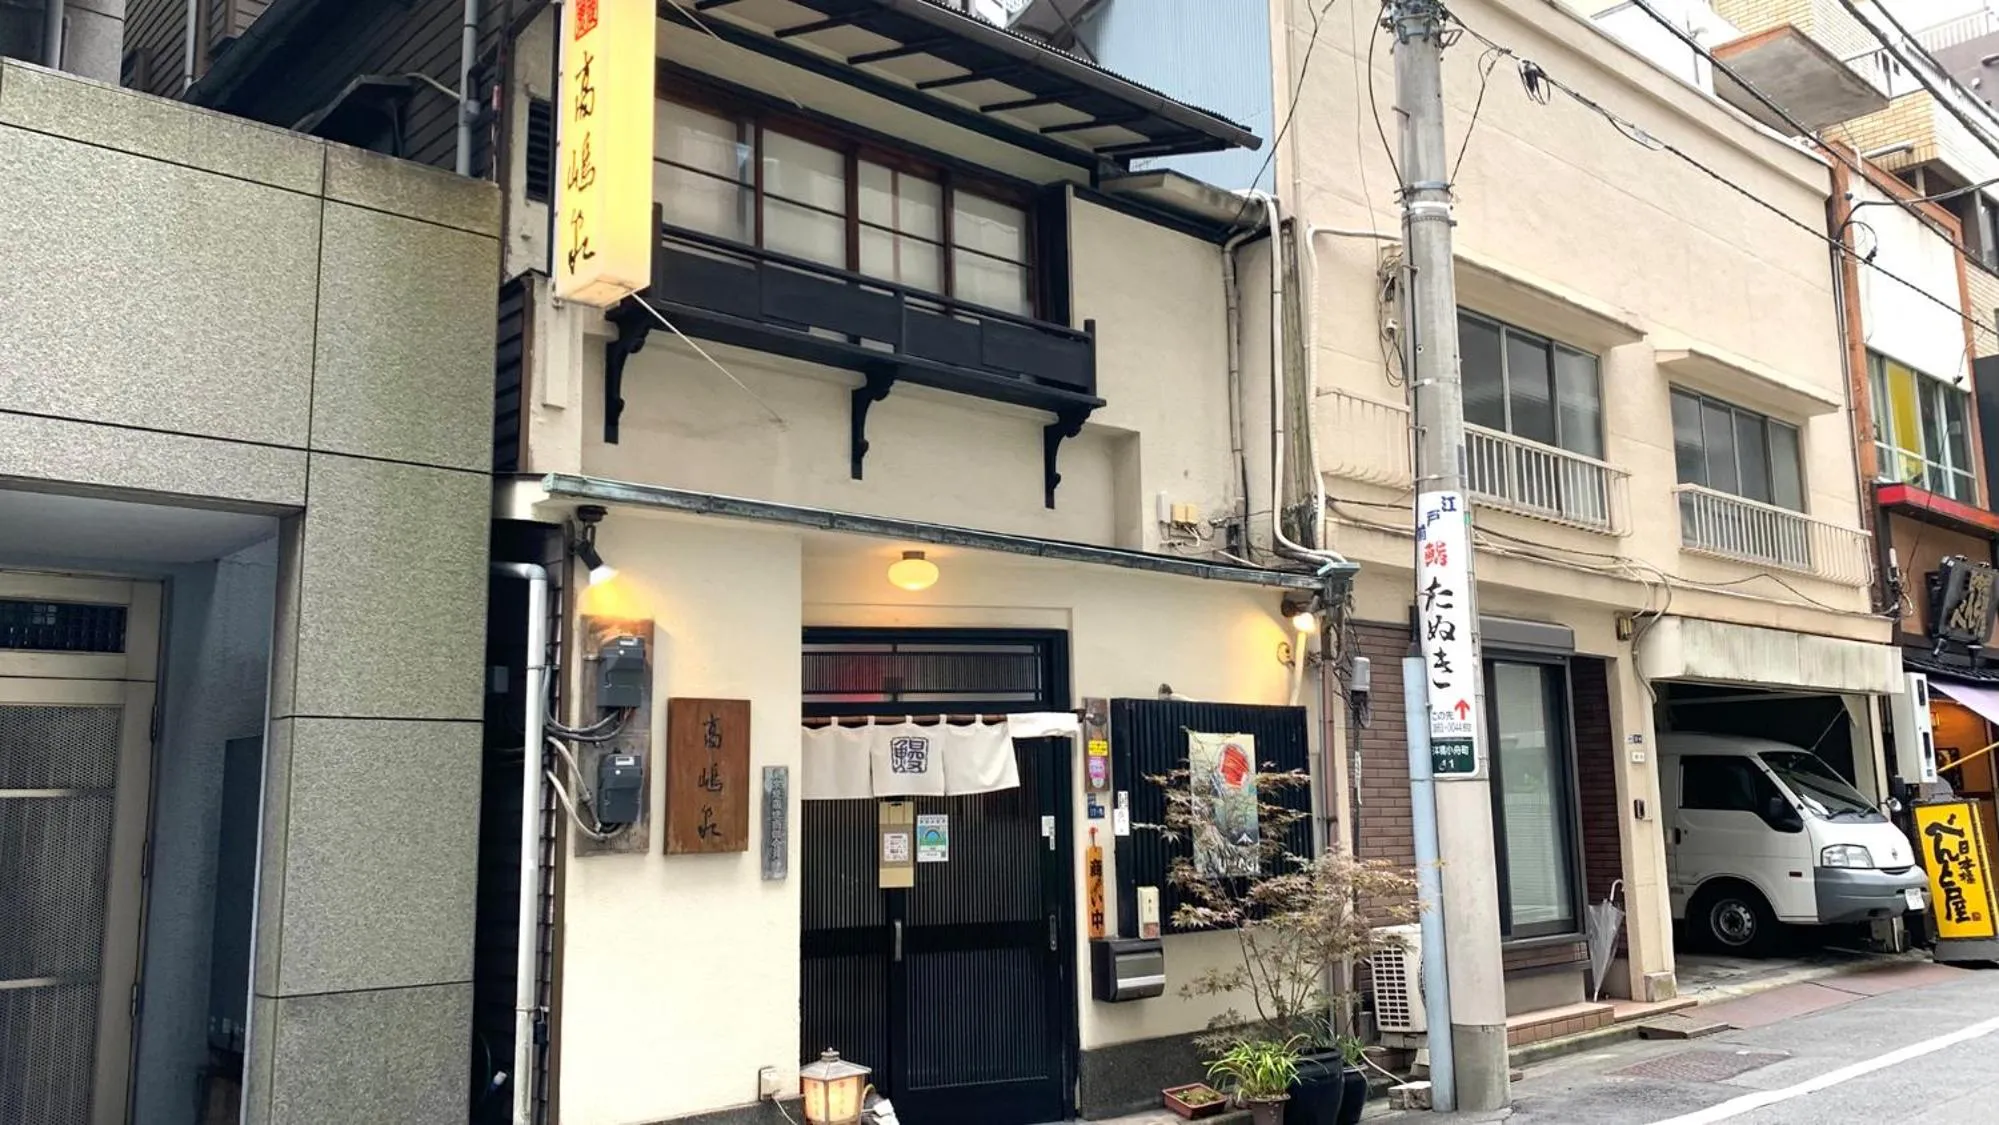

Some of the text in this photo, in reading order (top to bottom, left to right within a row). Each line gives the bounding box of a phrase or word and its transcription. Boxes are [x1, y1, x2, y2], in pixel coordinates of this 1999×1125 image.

[1417, 496, 1457, 541] 江戸前
[1422, 576, 1455, 690] たぬき
[1432, 711, 1455, 721] この先
[1217, 856, 1261, 874] UAGI
[1925, 813, 1971, 924] べんと屋
[1958, 840, 1976, 884] 日本橋
